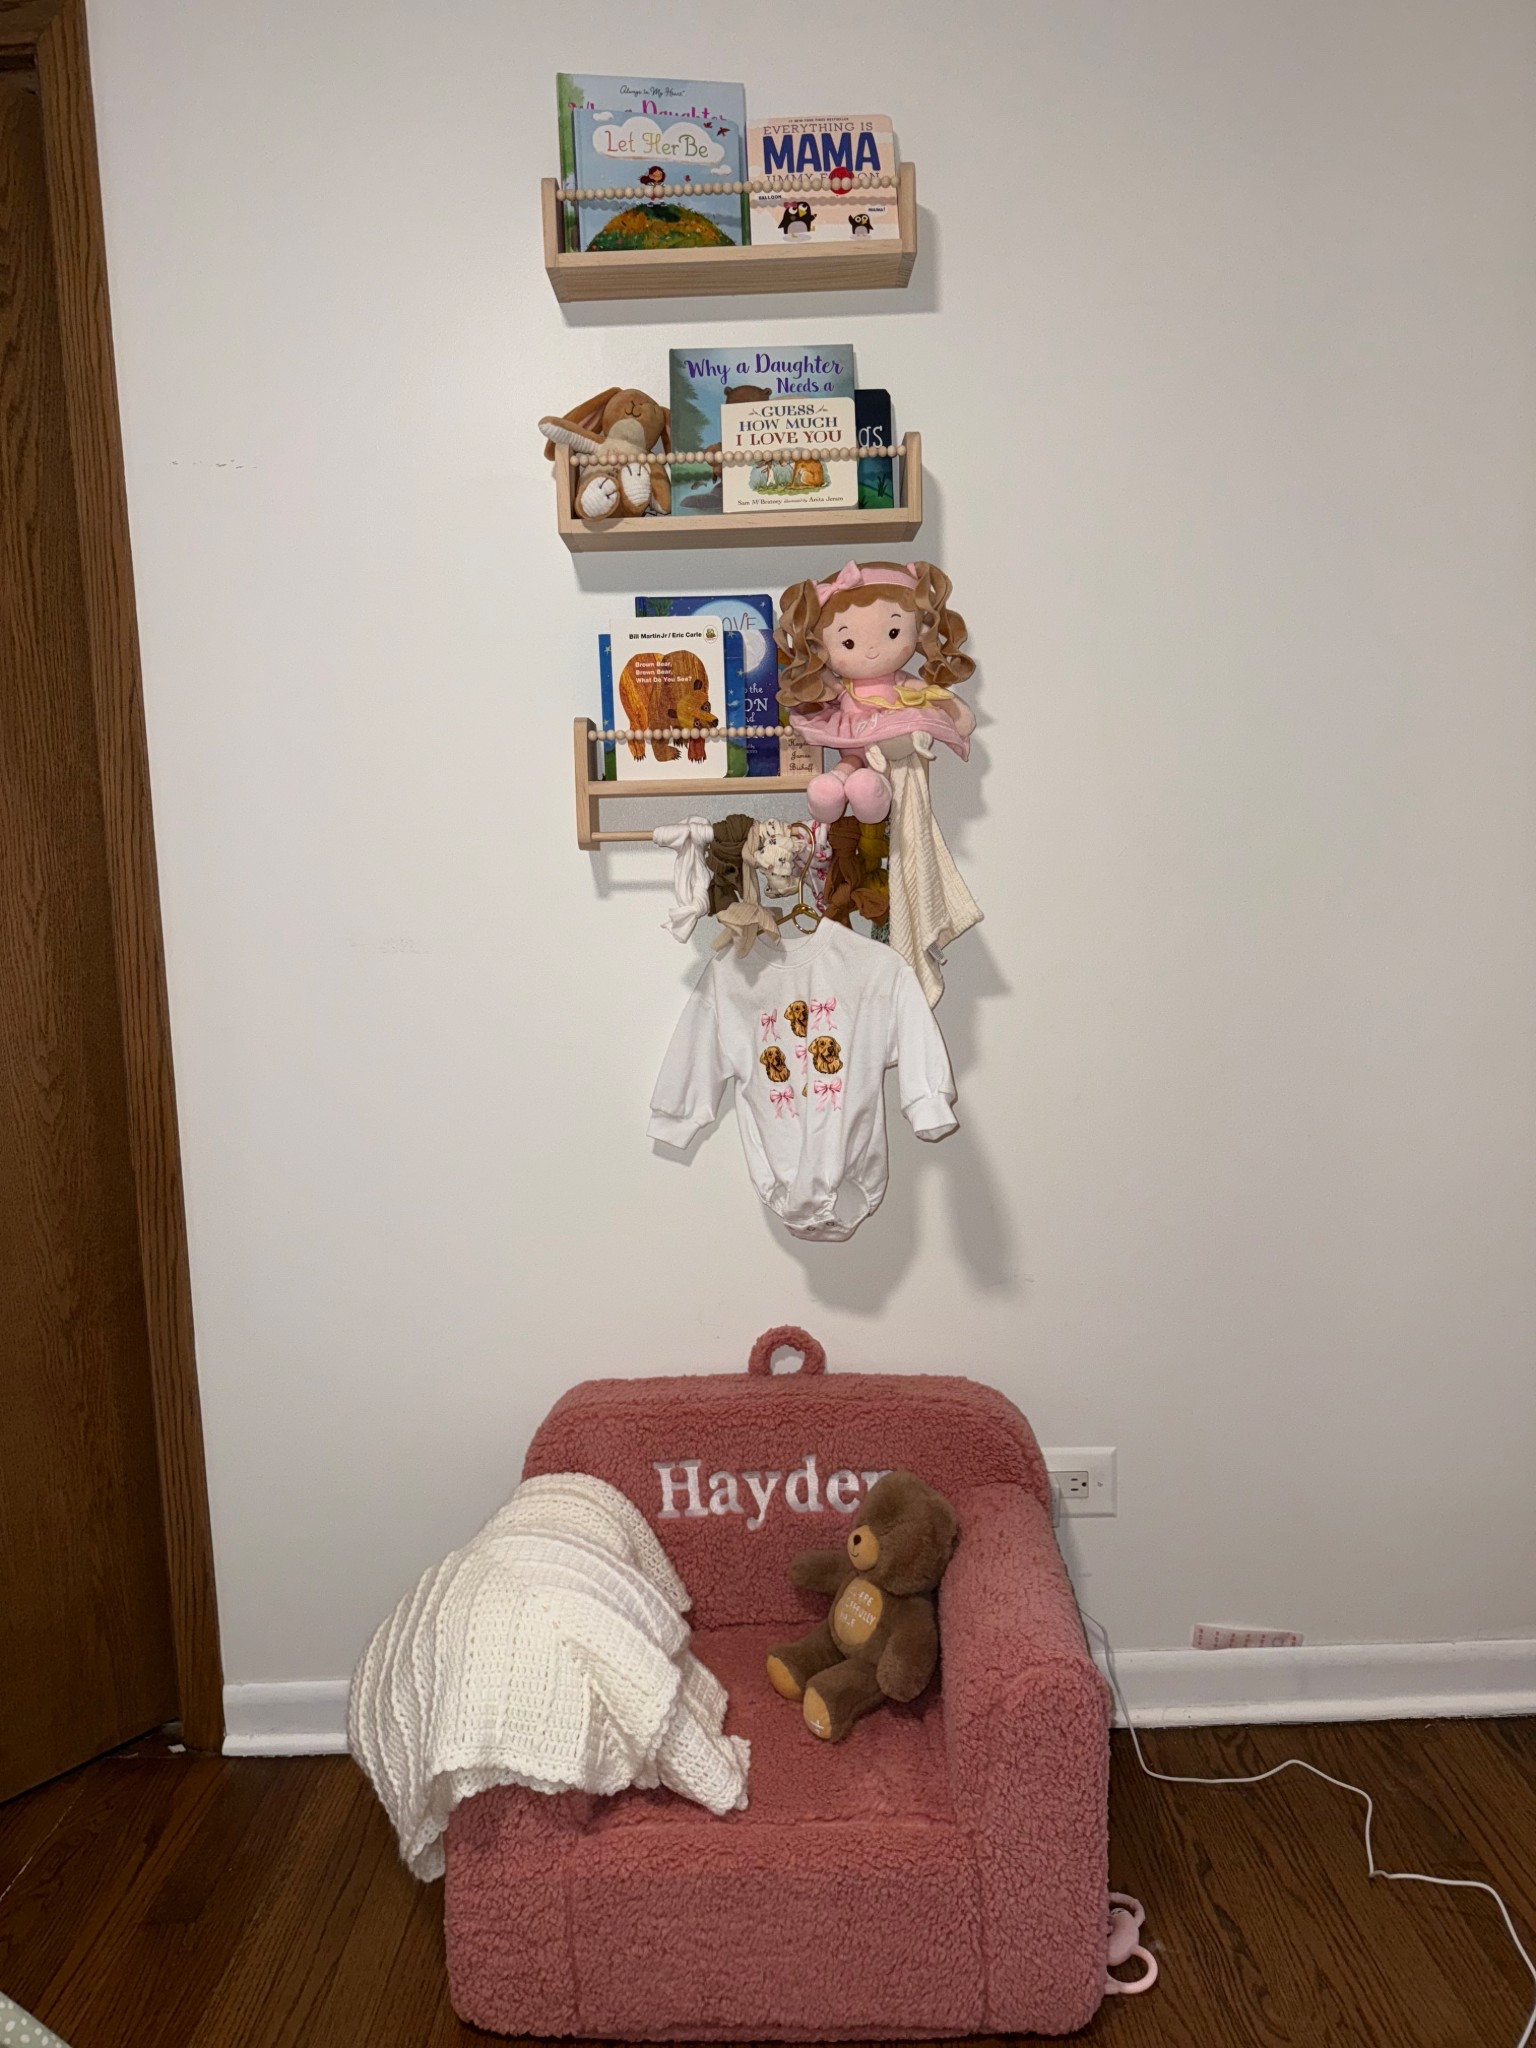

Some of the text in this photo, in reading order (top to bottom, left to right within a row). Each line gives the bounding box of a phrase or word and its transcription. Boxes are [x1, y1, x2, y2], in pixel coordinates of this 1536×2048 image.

[763, 122, 874, 135] EVERYTHING IS
[604, 130, 709, 158] Let Her Be
[762, 132, 881, 174] MAMA
[683, 353, 844, 385] Why a Daughter
[776, 377, 835, 393] Needs a
[760, 404, 815, 417] GUESS
[739, 416, 838, 432] HOW MUCH
[735, 430, 843, 447] I LOVE YOU
[722, 612, 757, 630] OVE
[749, 683, 764, 694] the
